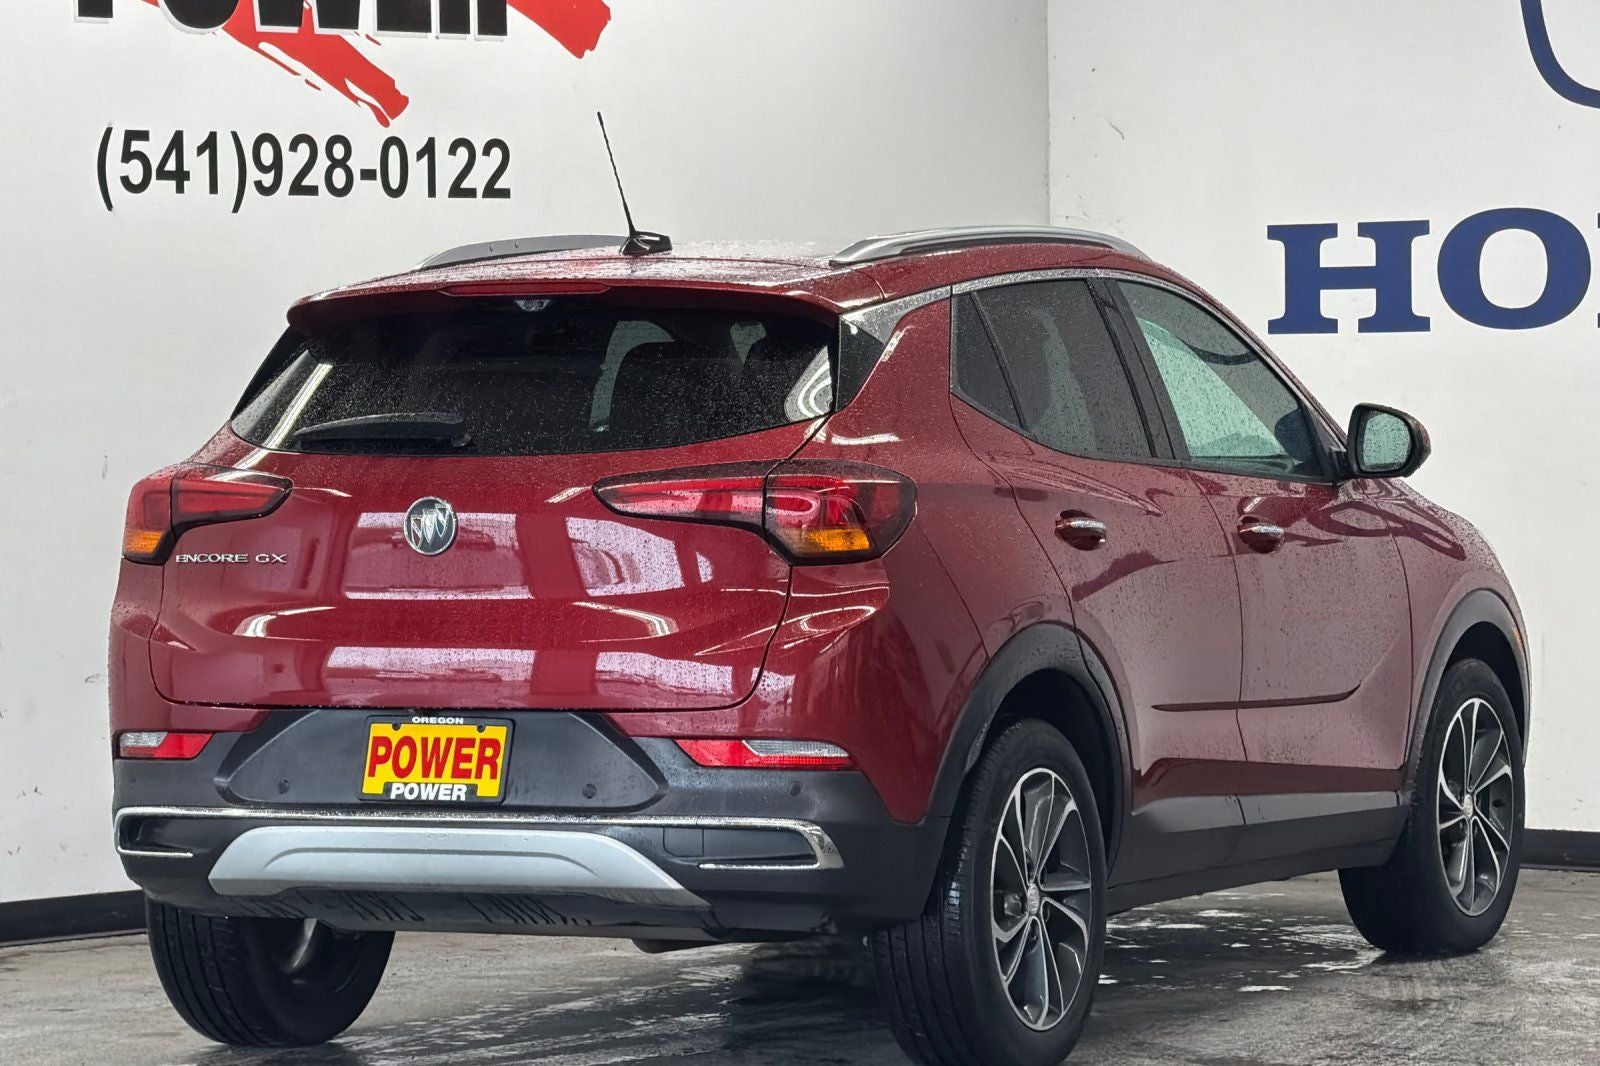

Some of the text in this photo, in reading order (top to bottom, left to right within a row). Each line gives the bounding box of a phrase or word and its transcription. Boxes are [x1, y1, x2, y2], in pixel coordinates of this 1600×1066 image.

[97, 125, 511, 213] (541)928-0122
[1267, 207, 1600, 334] HO
[175, 553, 288, 563] ENCORE GX
[411, 716, 464, 724] OREGON
[367, 735, 501, 780] POWER
[390, 782, 467, 801] POWER
